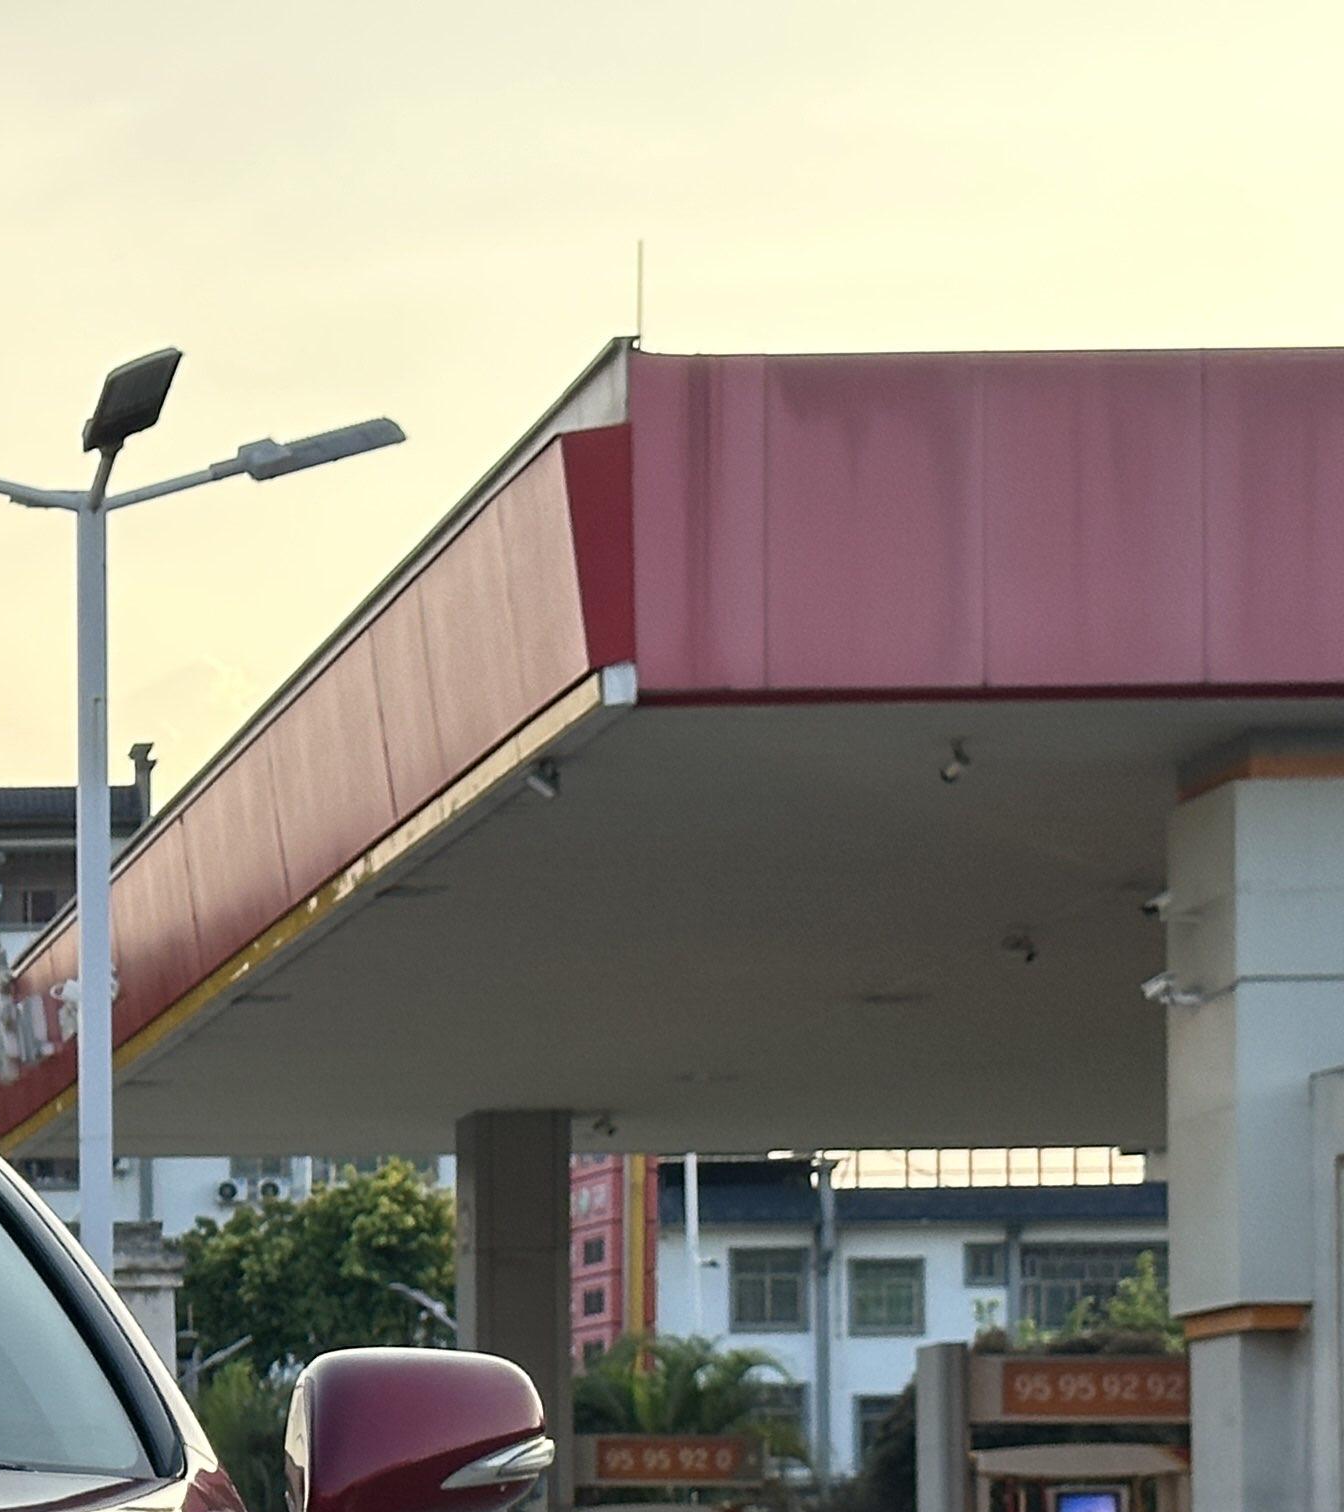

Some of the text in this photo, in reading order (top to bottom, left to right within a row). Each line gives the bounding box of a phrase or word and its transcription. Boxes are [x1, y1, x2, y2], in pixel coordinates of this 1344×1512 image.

[1014, 1373, 1053, 1402] 95
[1058, 1373, 1097, 1401] 95
[1102, 1373, 1140, 1401] 92
